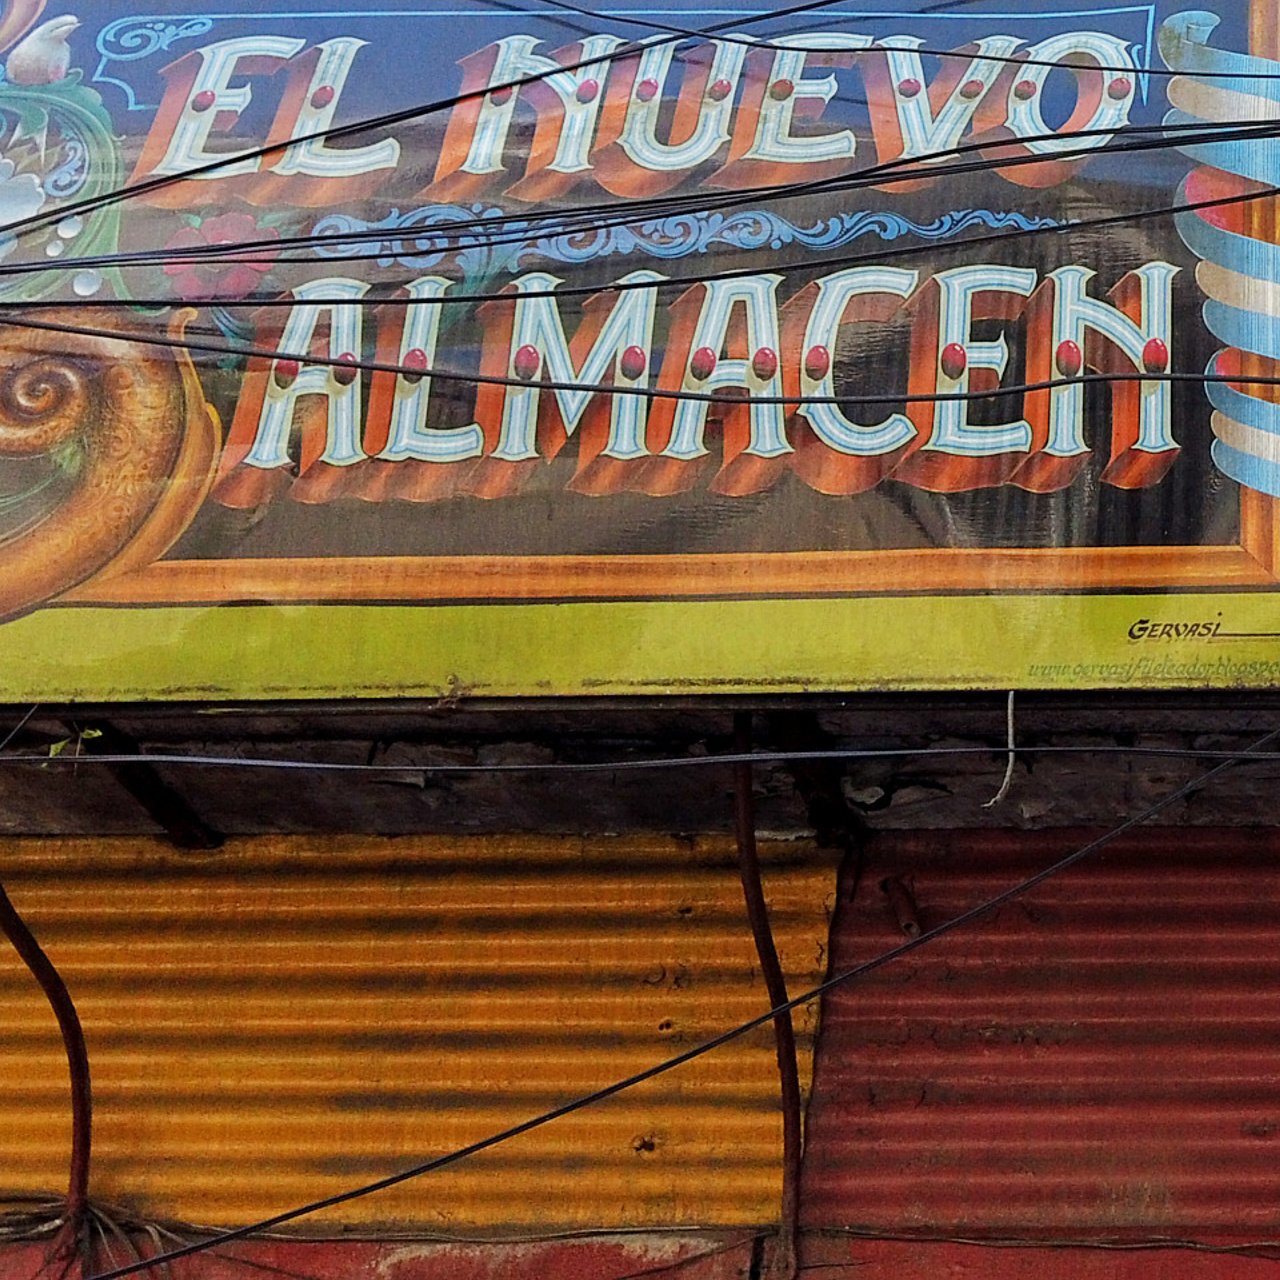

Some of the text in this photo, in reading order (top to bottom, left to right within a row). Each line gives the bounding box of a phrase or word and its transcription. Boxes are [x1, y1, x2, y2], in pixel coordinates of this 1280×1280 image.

[158, 31, 1137, 180] EL NUEVO
[243, 260, 1182, 467] ALMACEN
